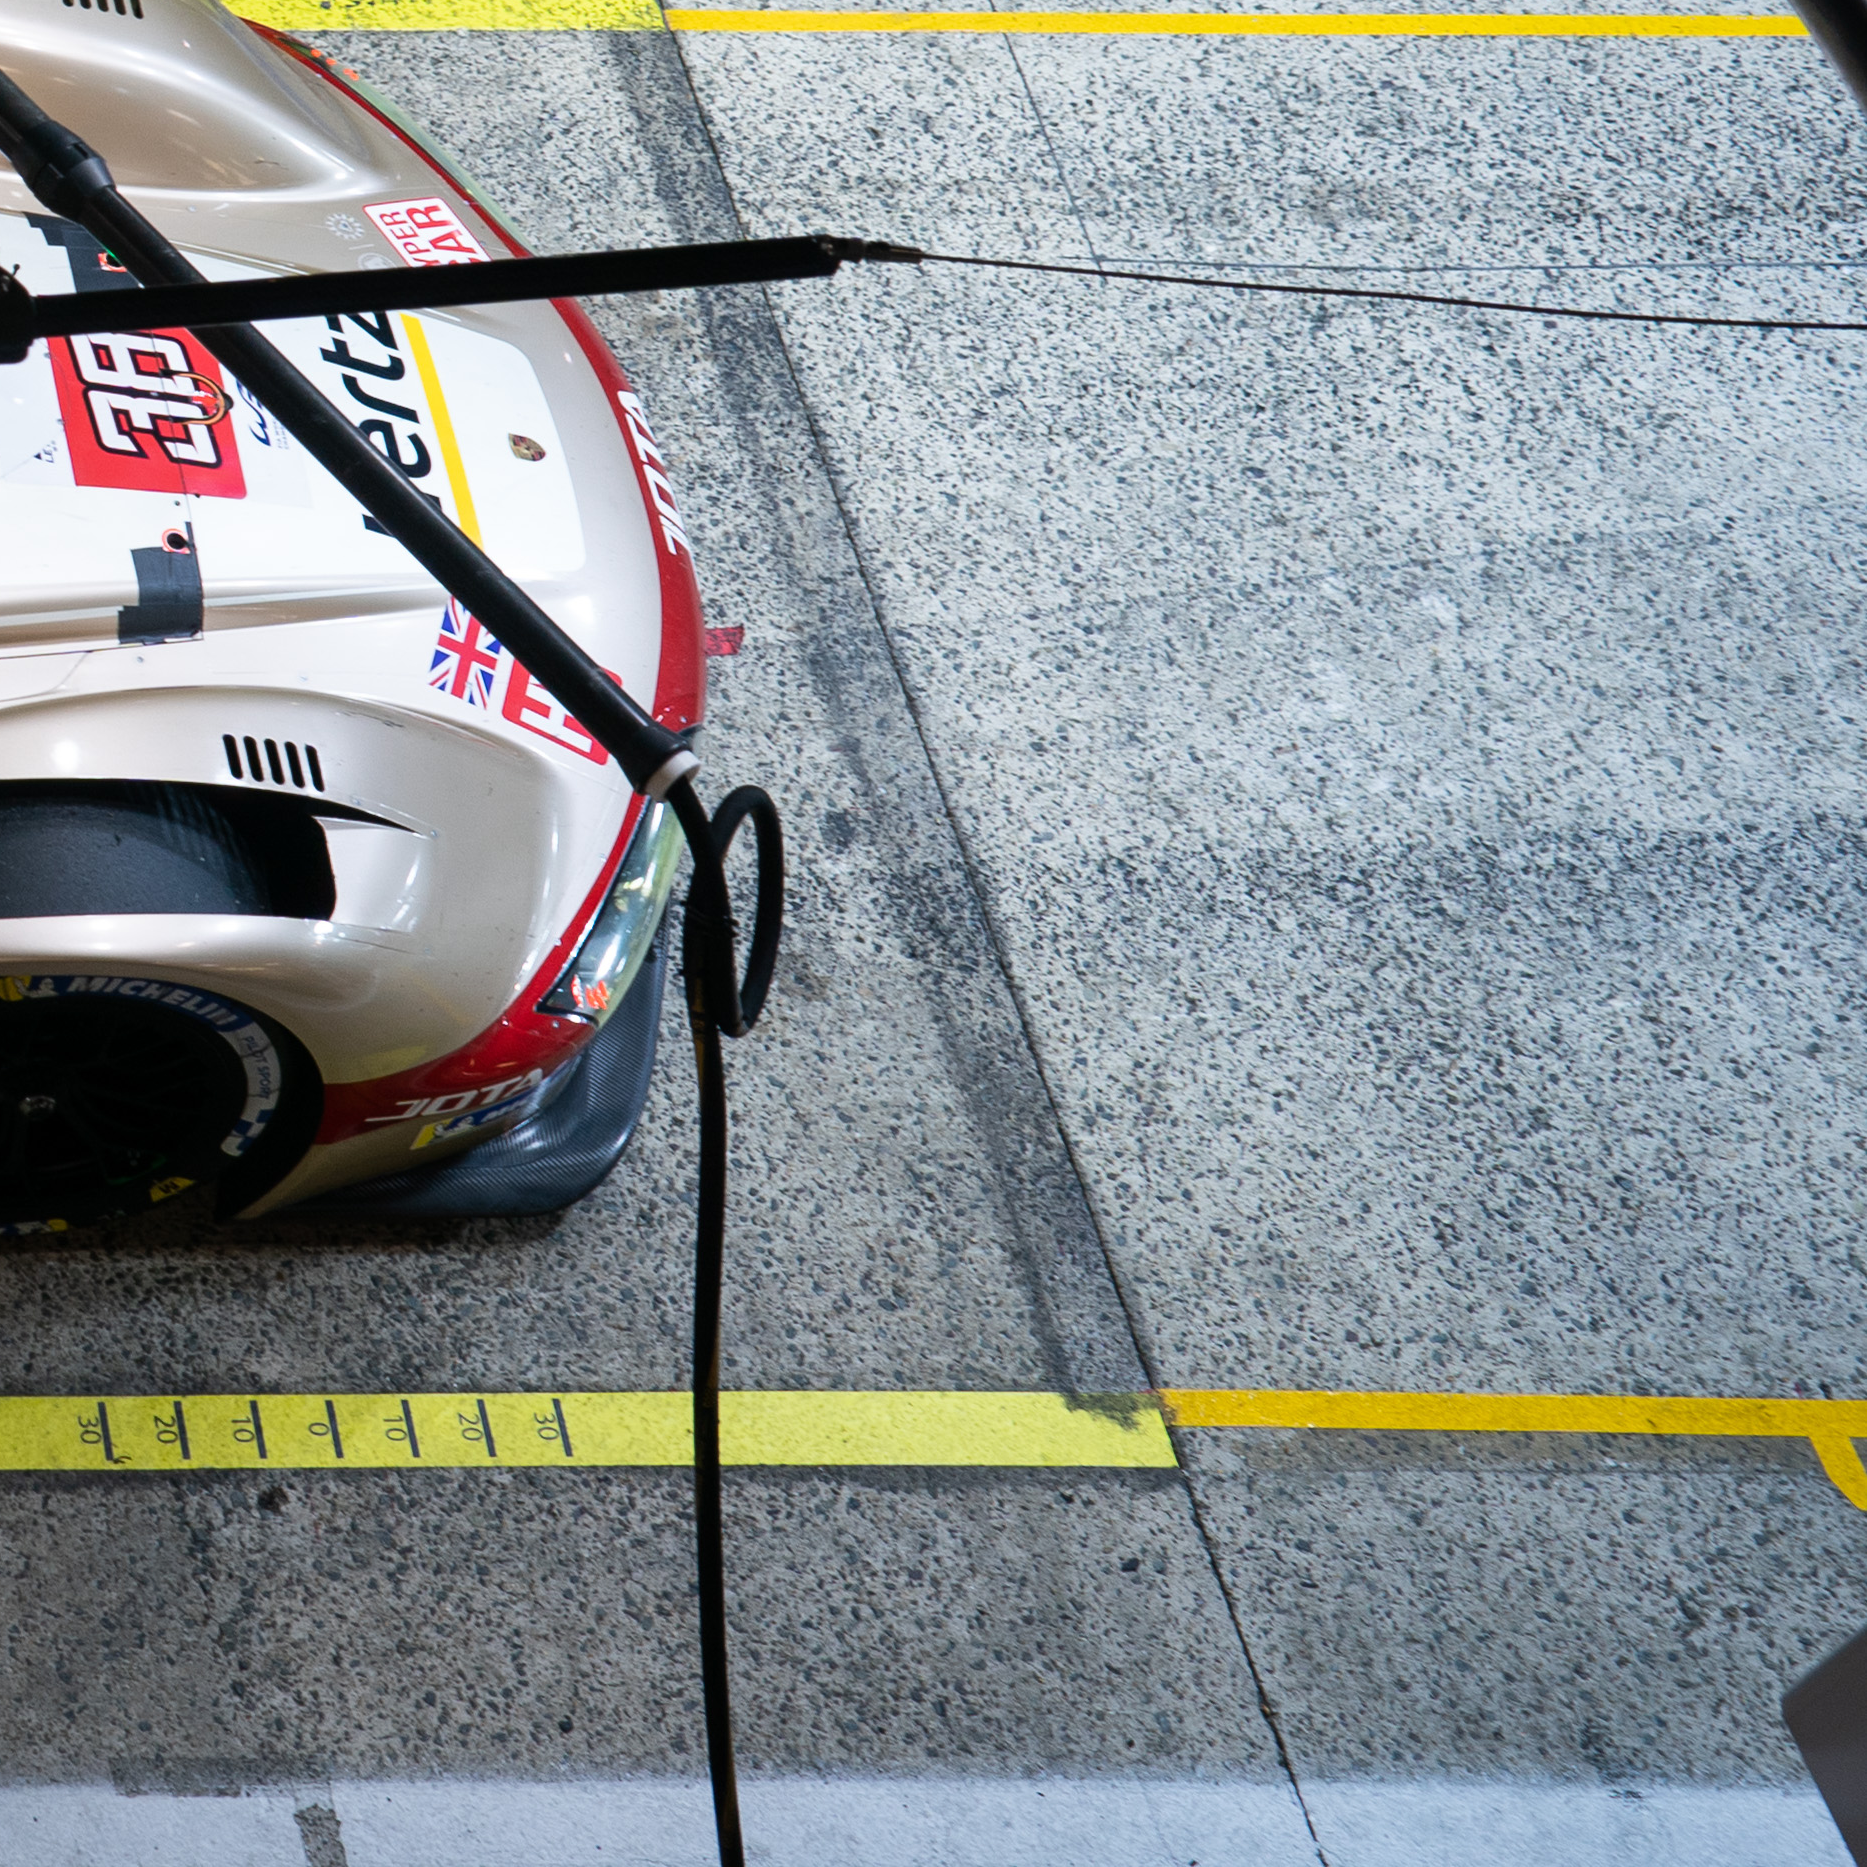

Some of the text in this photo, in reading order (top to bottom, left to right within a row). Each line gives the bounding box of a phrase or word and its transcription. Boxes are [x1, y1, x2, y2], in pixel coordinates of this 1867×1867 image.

[379, 211, 441, 267] YPER
[405, 204, 484, 266] AR
[66, 329, 223, 470] 38
[67, 976, 239, 1027] MICHELIN
[365, 1067, 544, 1122] JOTA
